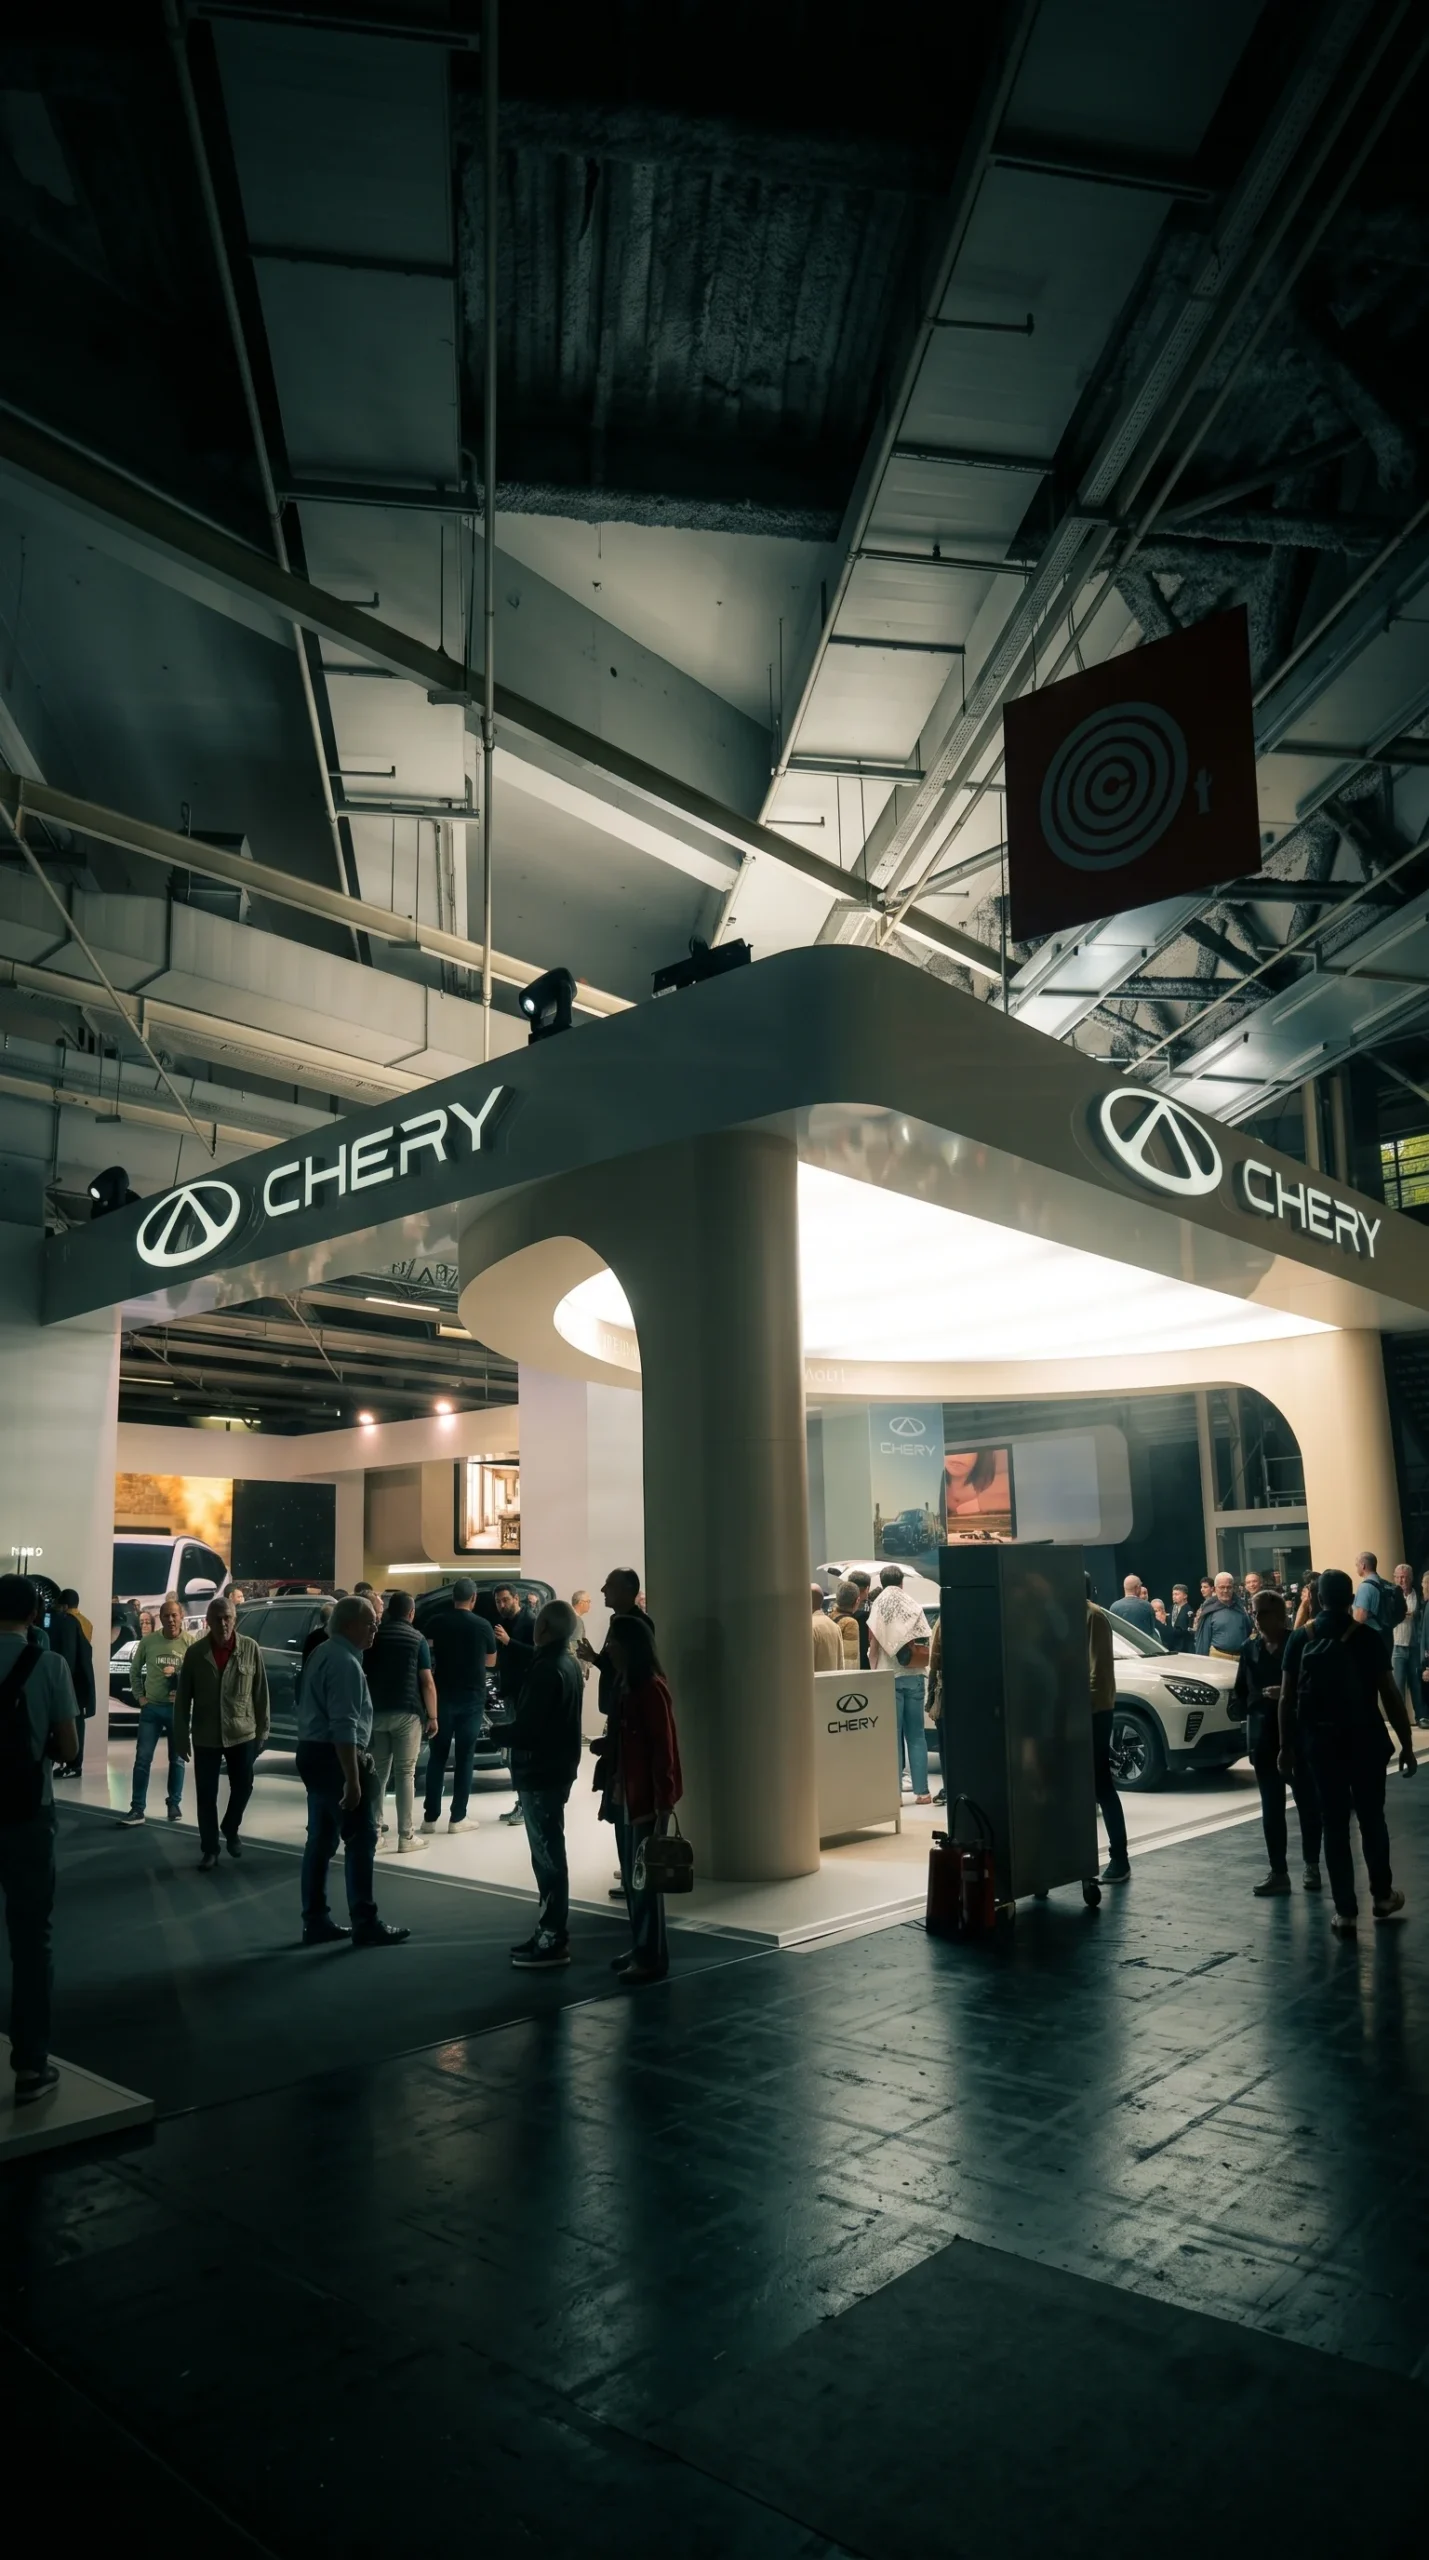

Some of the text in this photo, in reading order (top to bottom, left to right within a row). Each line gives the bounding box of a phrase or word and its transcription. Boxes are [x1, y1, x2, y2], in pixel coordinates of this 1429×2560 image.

[263, 1085, 504, 1217] CHERY
[1242, 1159, 1381, 1258] CHERY
[880, 1442, 936, 1457] CHERY
[828, 1716, 879, 1734] CHERY
